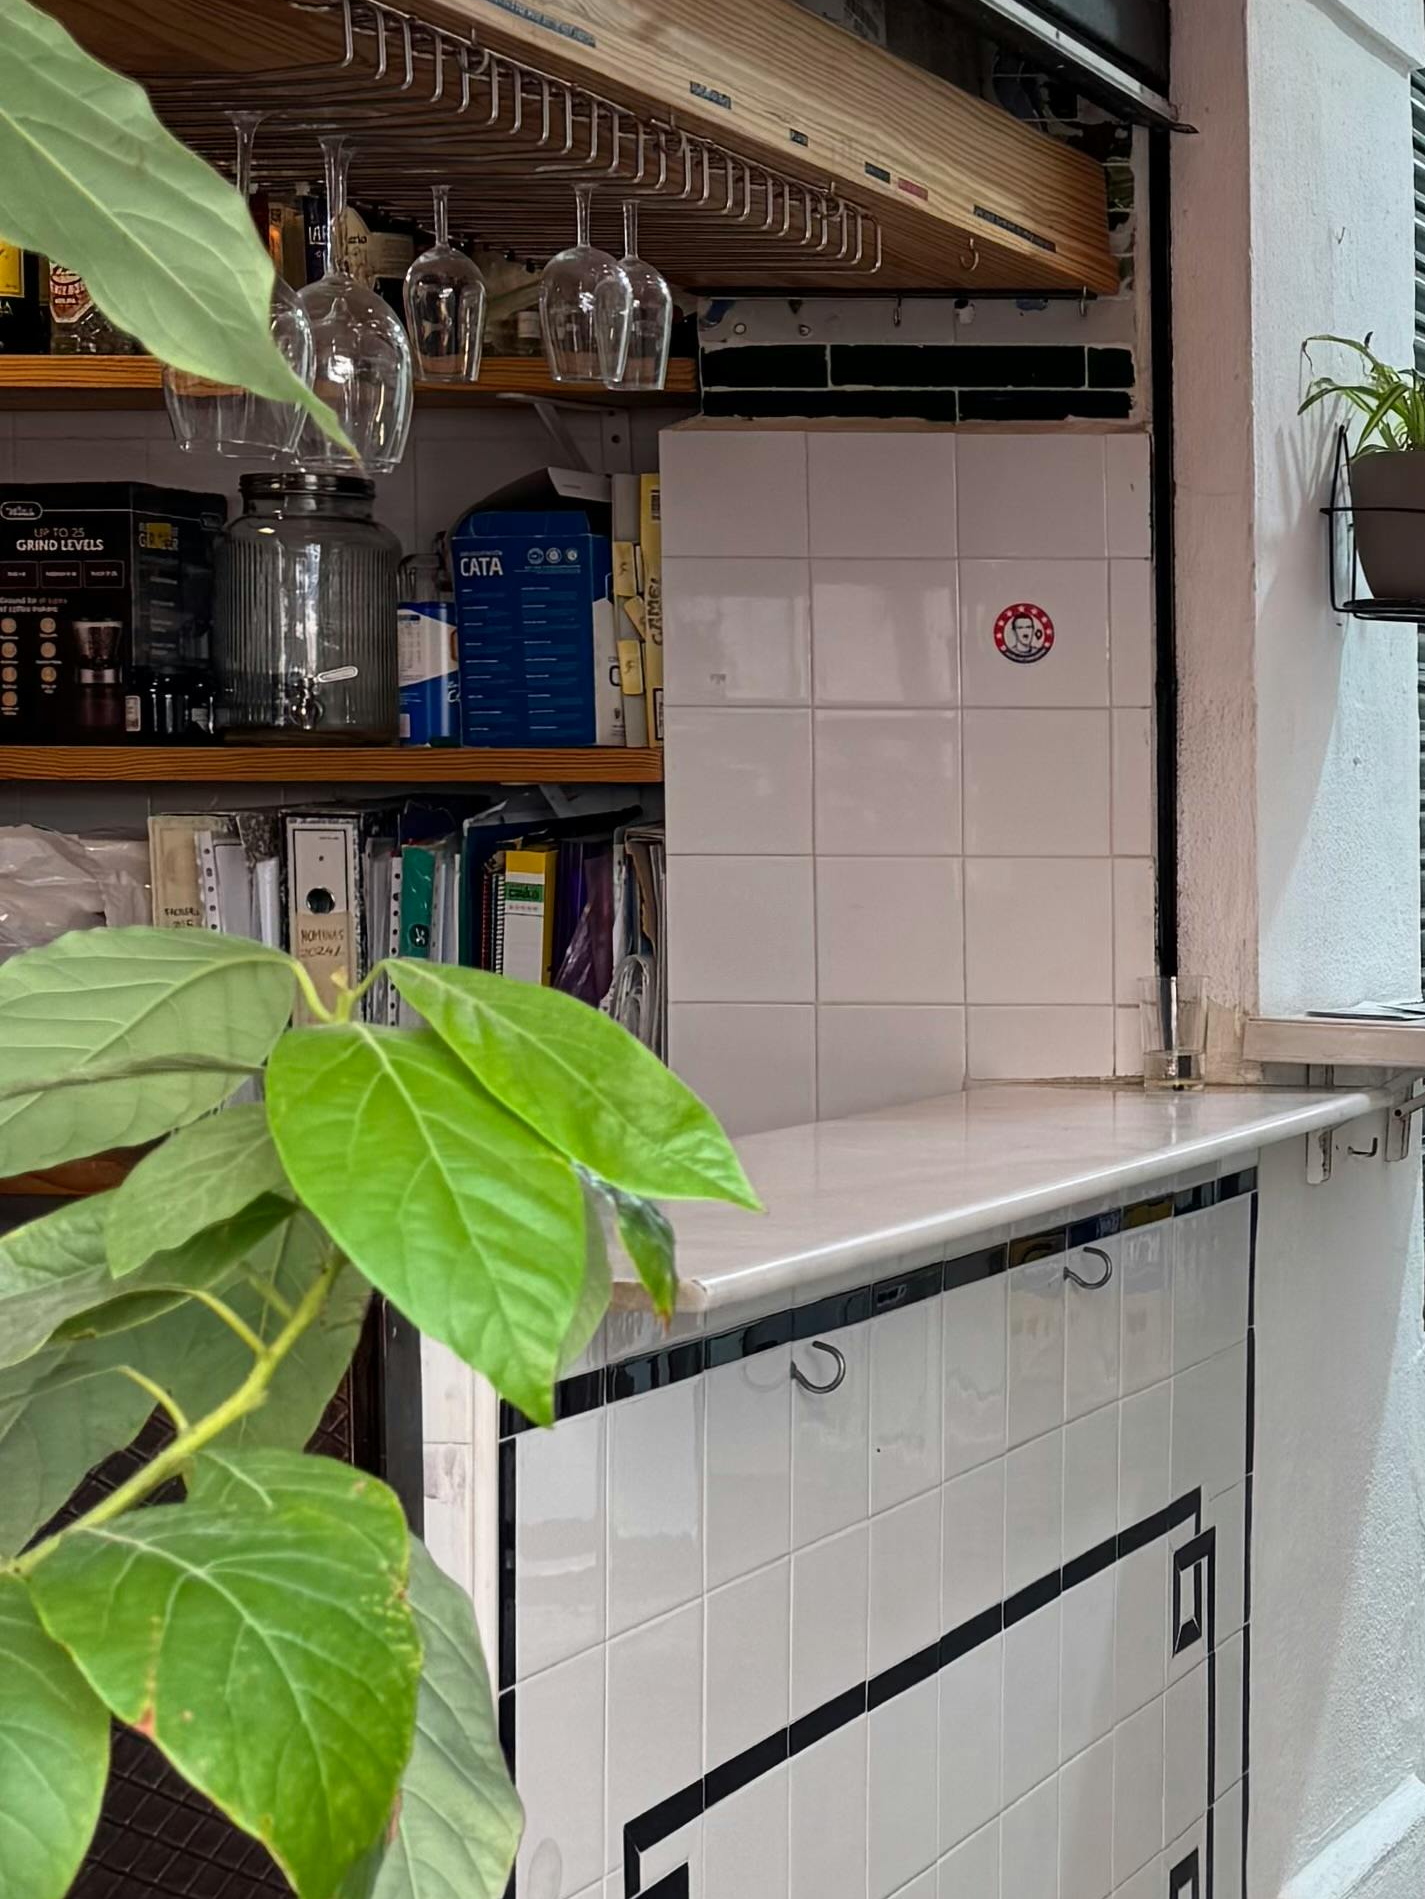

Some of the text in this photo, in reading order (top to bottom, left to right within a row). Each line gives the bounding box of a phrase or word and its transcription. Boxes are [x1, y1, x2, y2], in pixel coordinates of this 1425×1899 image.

[53, 528, 68, 538] TO
[16, 539, 104, 551] GRIND LEVELS
[460, 557, 503, 577] CATA
